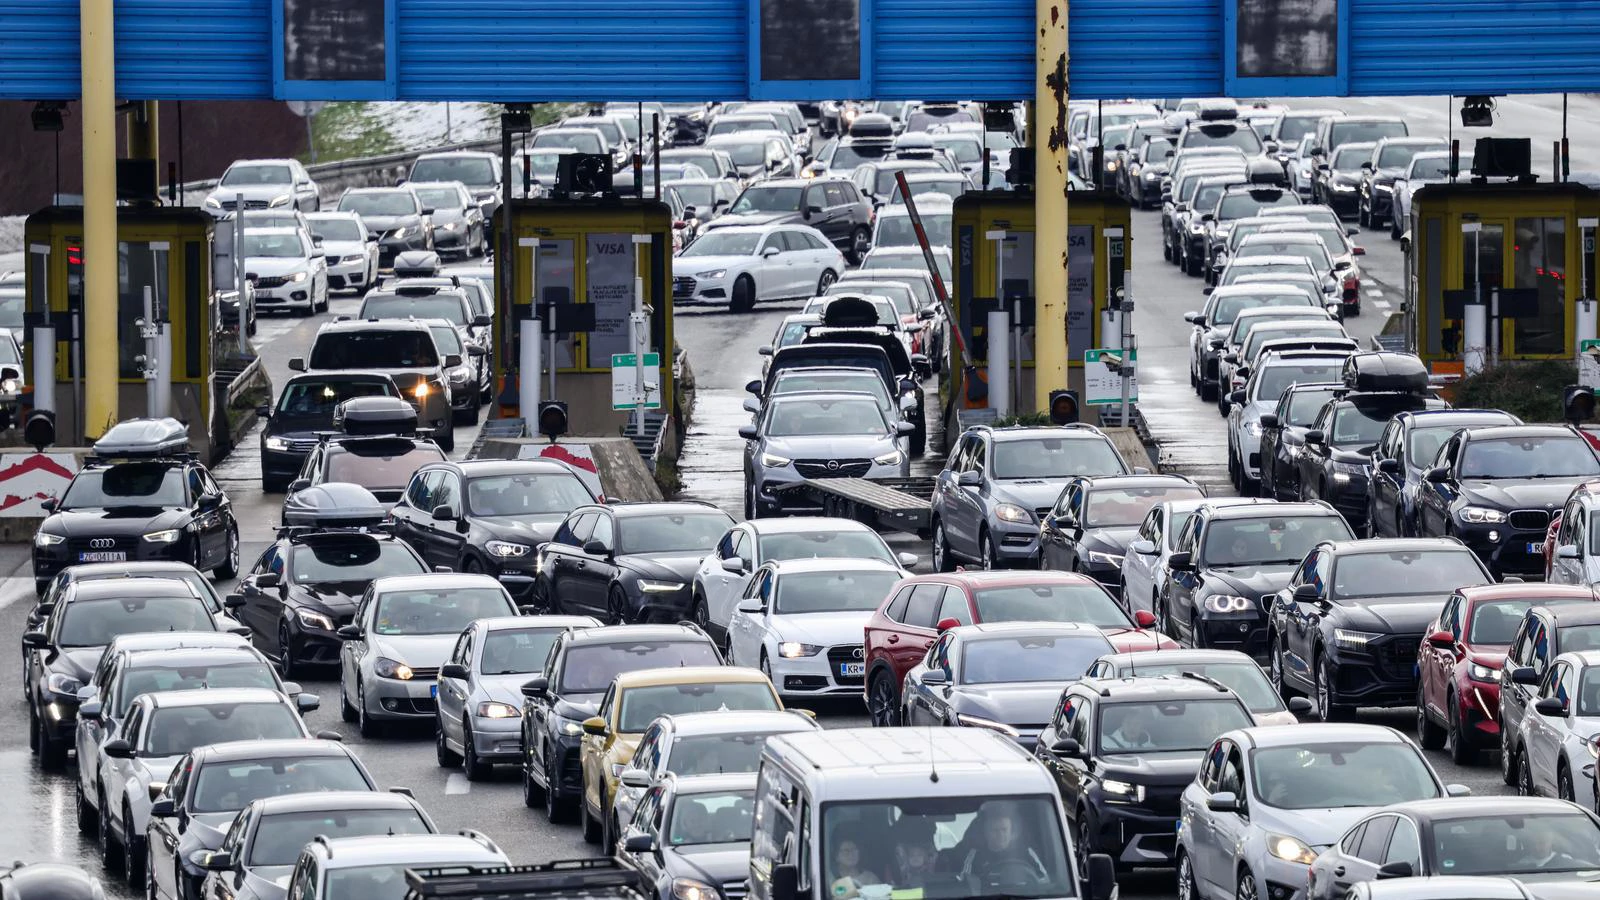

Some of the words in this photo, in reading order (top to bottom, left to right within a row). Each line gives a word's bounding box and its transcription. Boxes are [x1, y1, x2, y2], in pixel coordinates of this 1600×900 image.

[1068, 236, 1085, 247] SA
[596, 243, 626, 254] VISA
[962, 236, 971, 265] VISA
[1112, 243, 1123, 255] 15
[848, 665, 859, 673] KR
